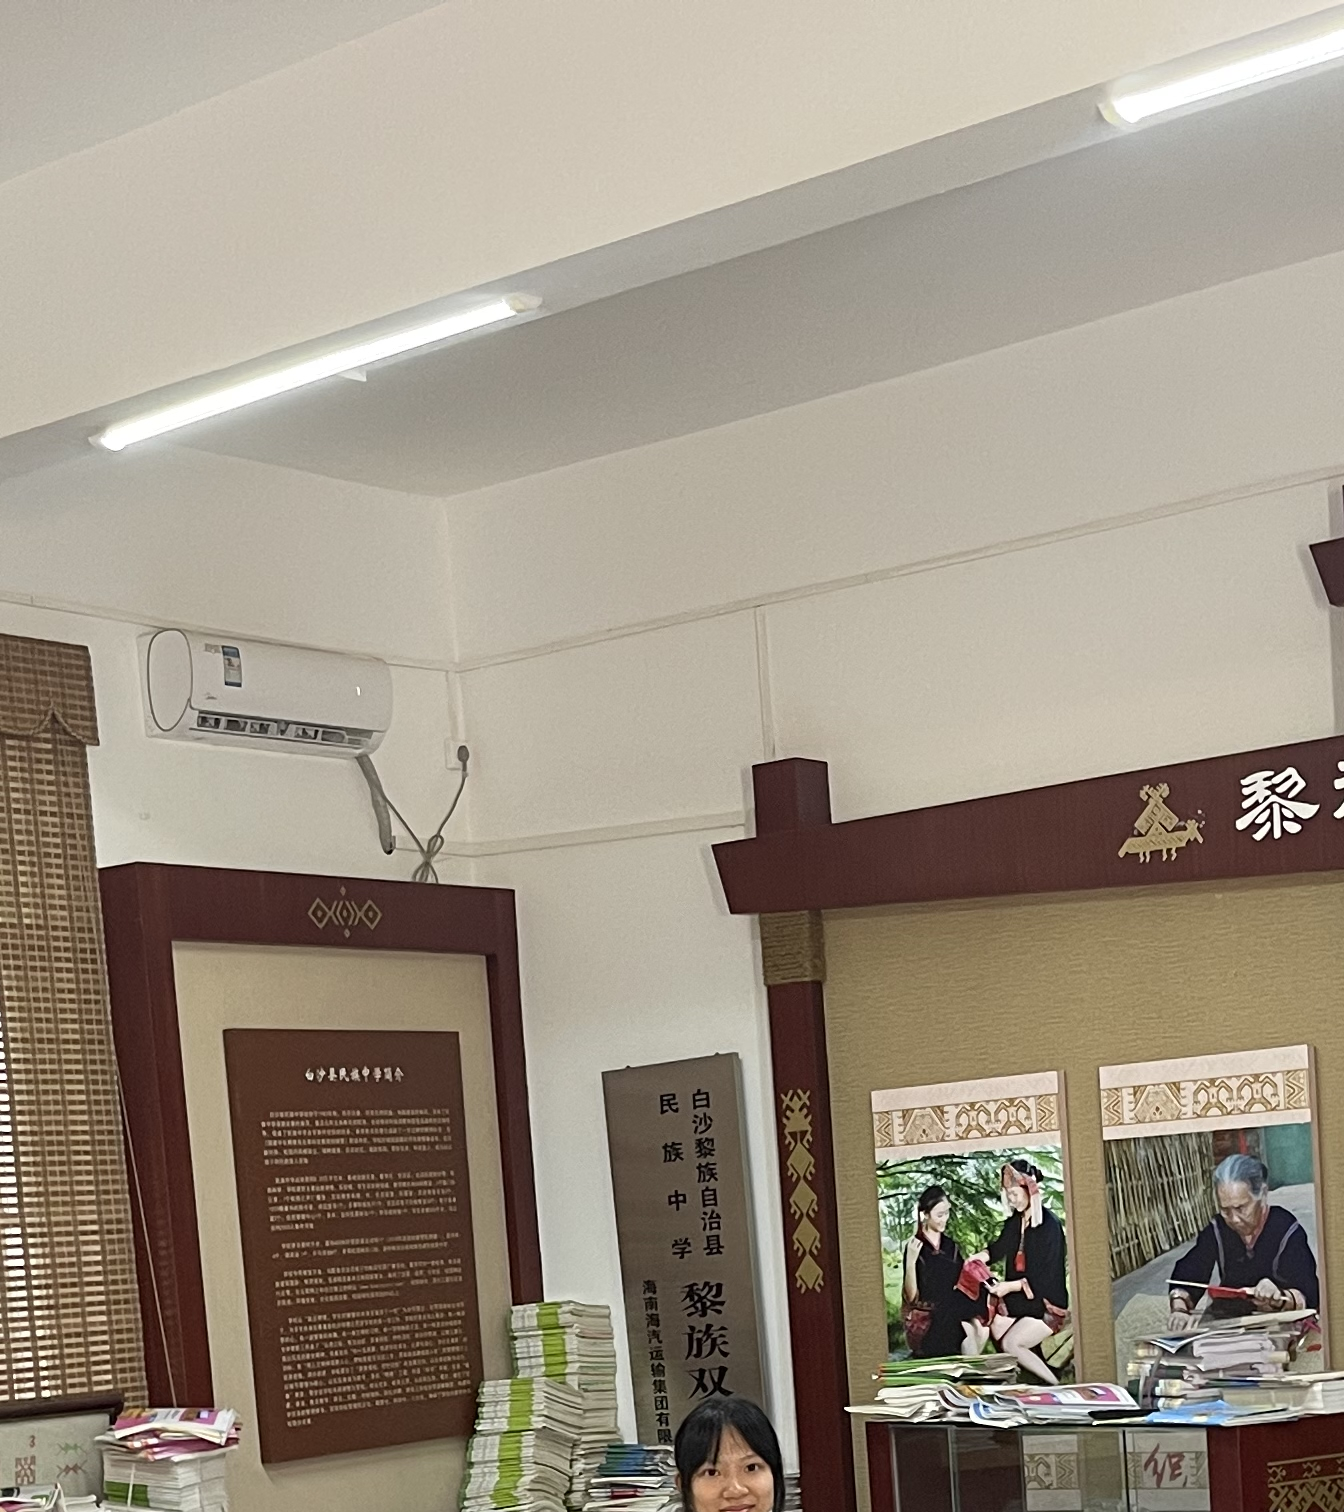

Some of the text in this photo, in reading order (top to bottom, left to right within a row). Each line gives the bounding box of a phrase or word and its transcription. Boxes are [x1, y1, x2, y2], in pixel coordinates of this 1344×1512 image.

[304, 1066, 405, 1083] 白沙县民族中学简介
[659, 1092, 693, 1260] 民族中学
[690, 1088, 725, 1257] 白沙黎族自治县
[642, 1279, 673, 1444] 海南海汽运输集团有限
[680, 1280, 734, 1400] 黎族双
